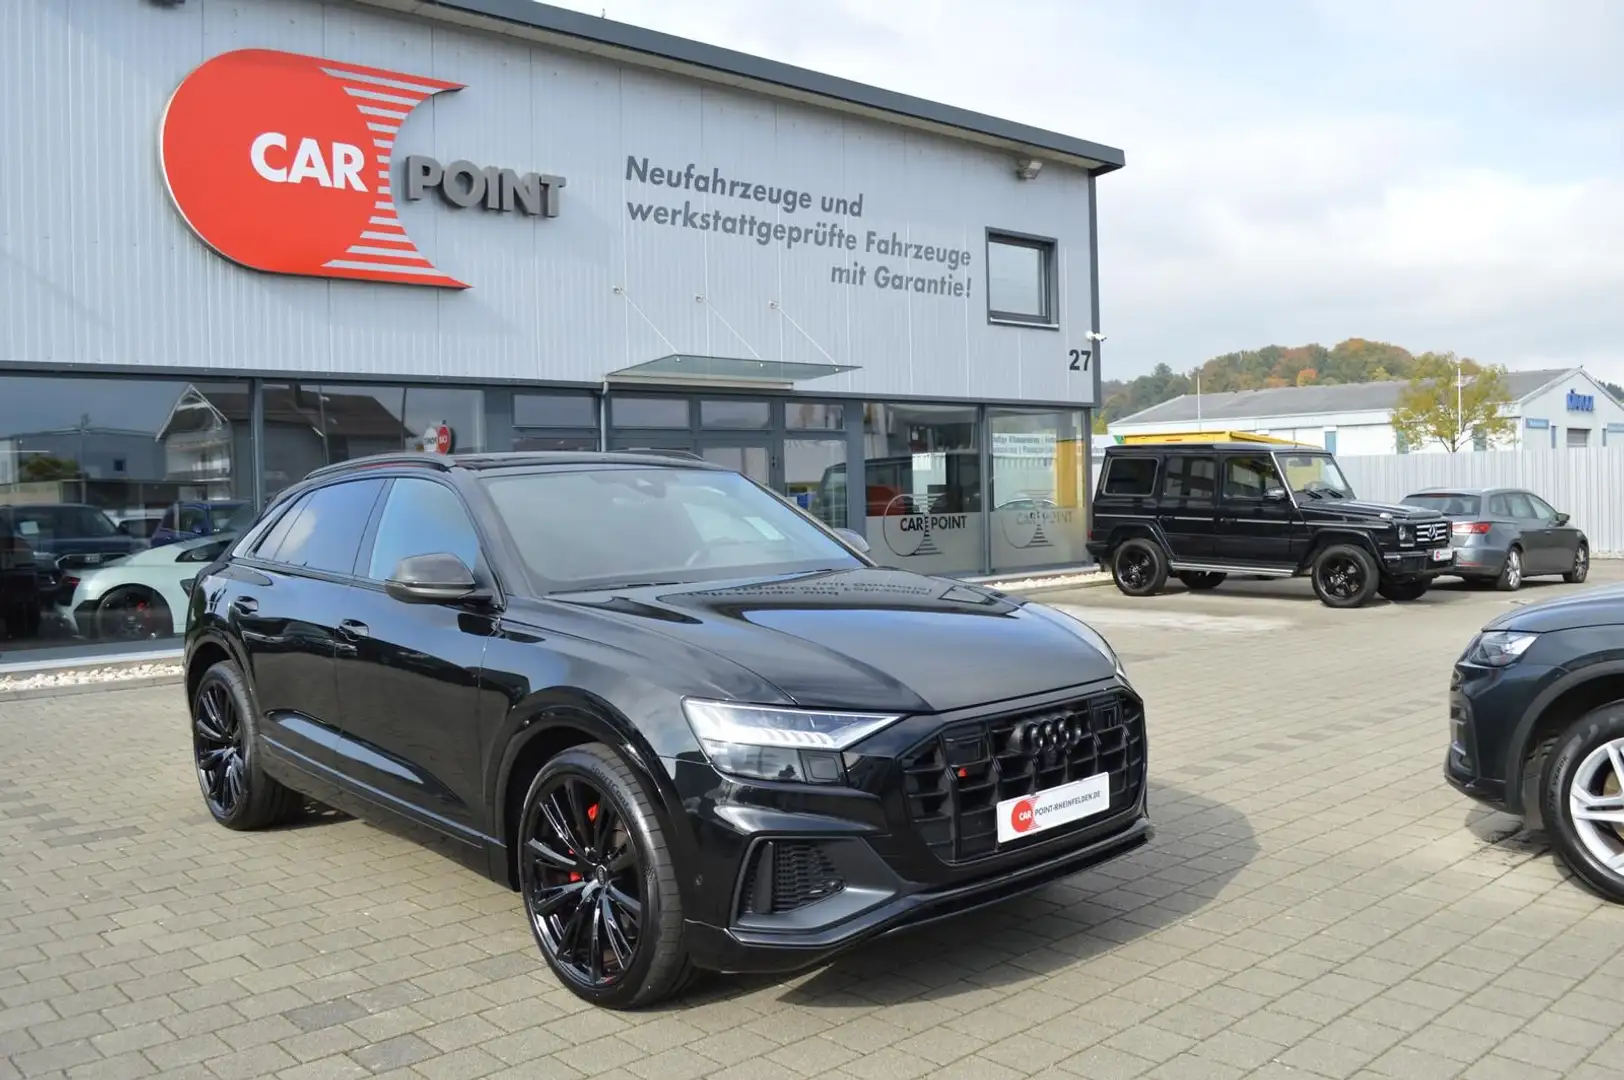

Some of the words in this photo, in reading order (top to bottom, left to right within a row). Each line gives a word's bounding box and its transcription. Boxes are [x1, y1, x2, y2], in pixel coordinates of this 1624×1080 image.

[251, 132, 369, 192] CAR
[406, 155, 566, 218] POINT
[625, 155, 812, 213] Neufahrzeuge
[821, 193, 864, 217] und
[627, 201, 857, 249] werkstattgeprüfte
[865, 230, 971, 270] Fahrzeuge
[831, 262, 866, 286] mit
[874, 265, 972, 298] Garantie!
[1069, 350, 1091, 371] 27
[900, 517, 922, 531] CAR
[931, 515, 966, 530] POINT
[1018, 811, 1032, 821] CAR
[1035, 790, 1100, 816] POINT-RHEINFELDEN.DE
